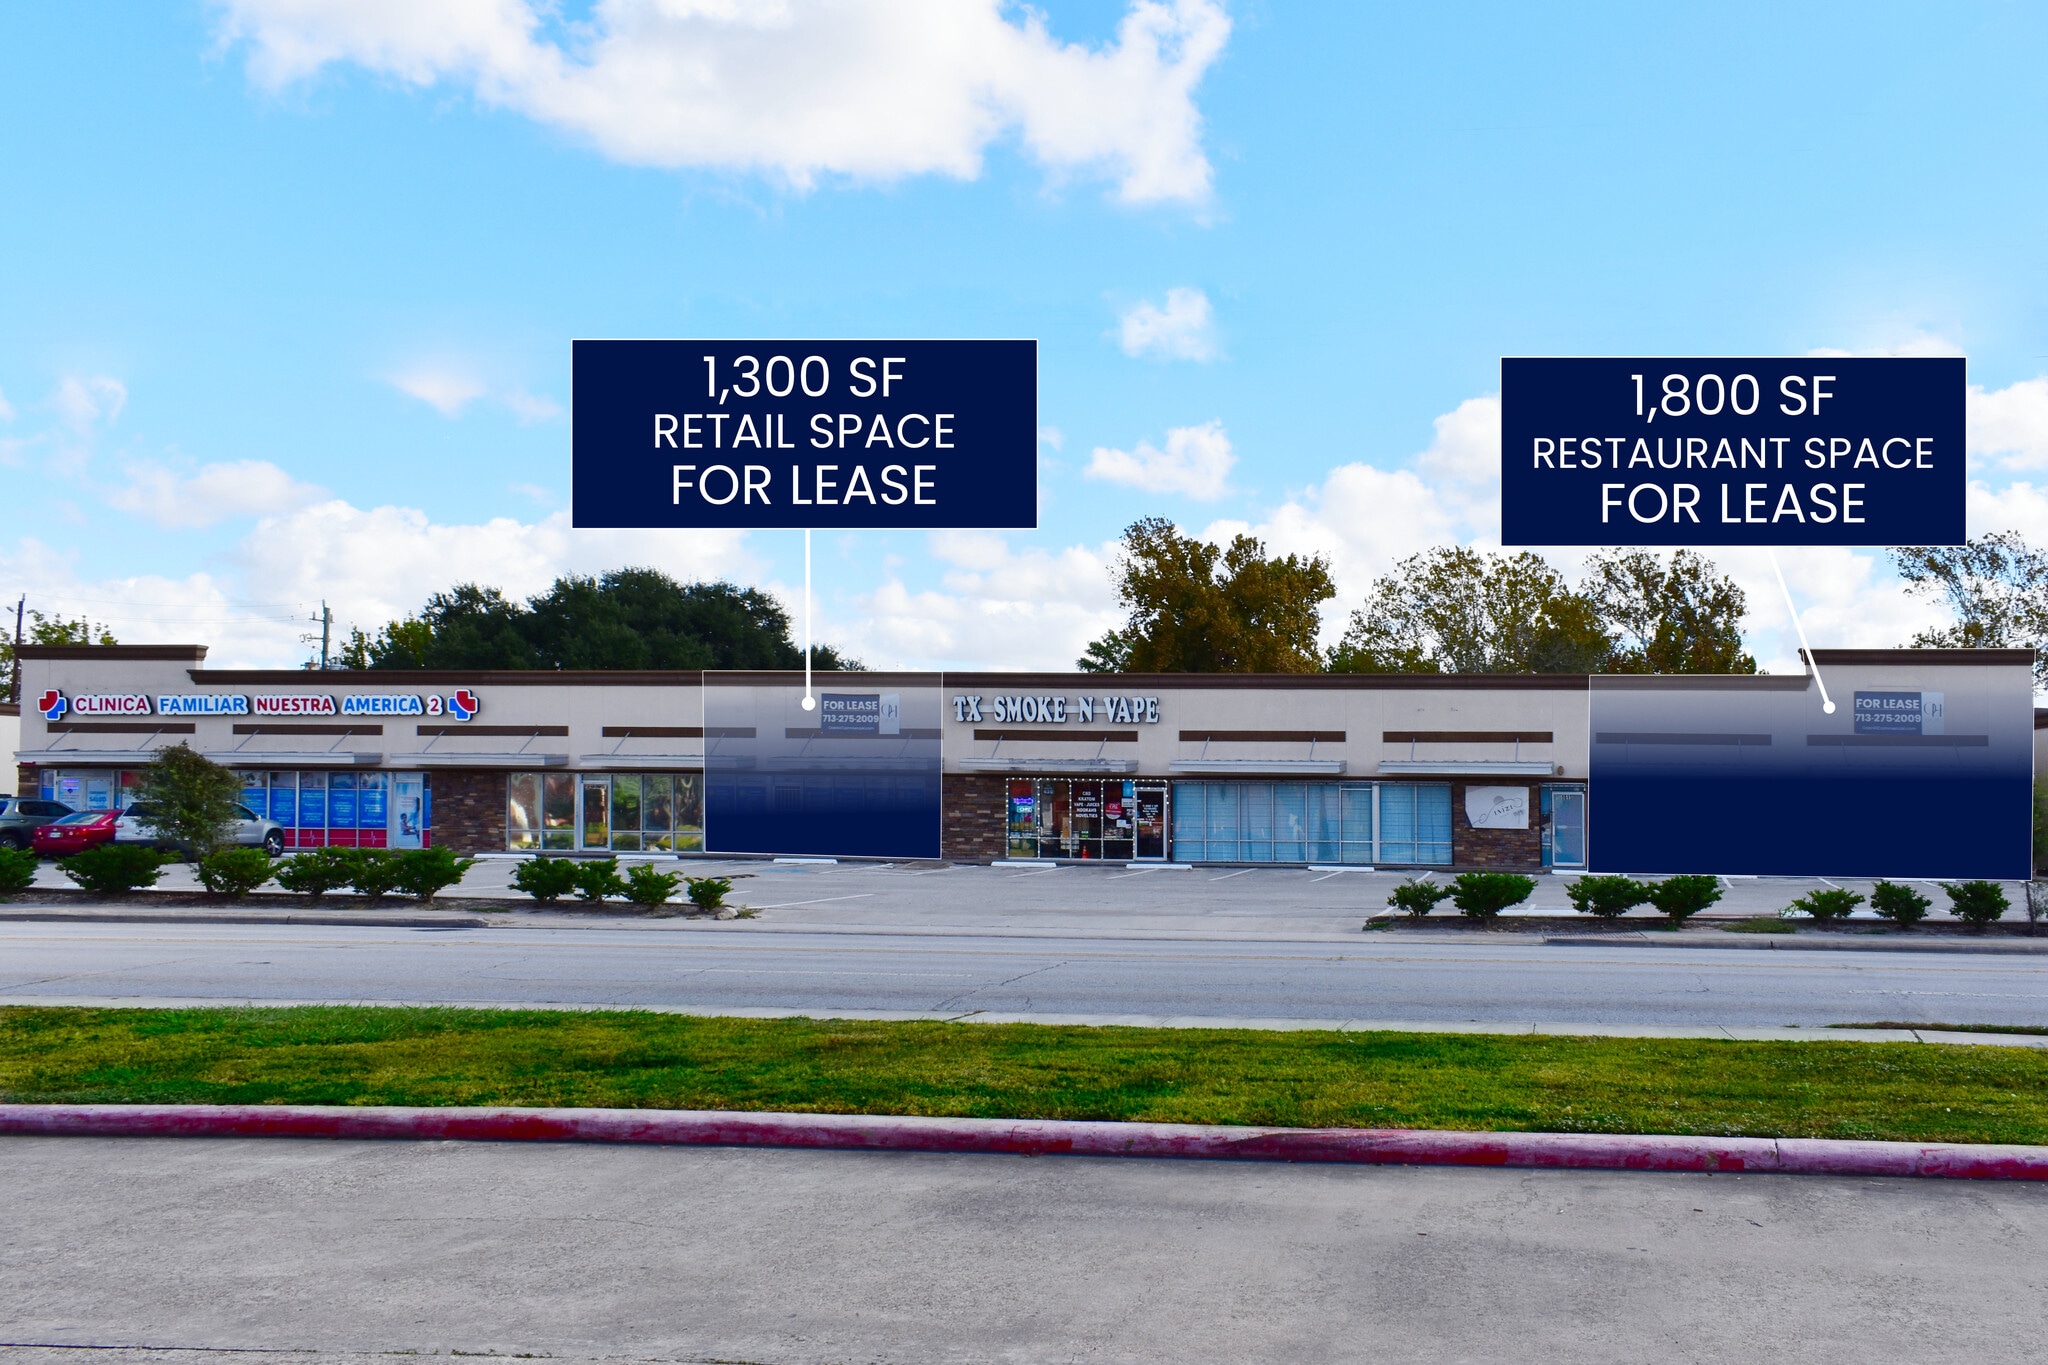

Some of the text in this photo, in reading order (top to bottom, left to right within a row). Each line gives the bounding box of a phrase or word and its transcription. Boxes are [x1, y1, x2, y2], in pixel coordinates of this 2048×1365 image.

[75, 697, 440, 712] CLINICA FAMILIAR NUESTRA AMERICA 2
[823, 700, 878, 710] FOR LEASE
[1856, 699, 1920, 709] FOR LEASE
[953, 696, 1160, 723] TX SMOKE N VAPE
[822, 714, 879, 723] 713-275-2009
[1854, 713, 1921, 723] 713-275-2009
